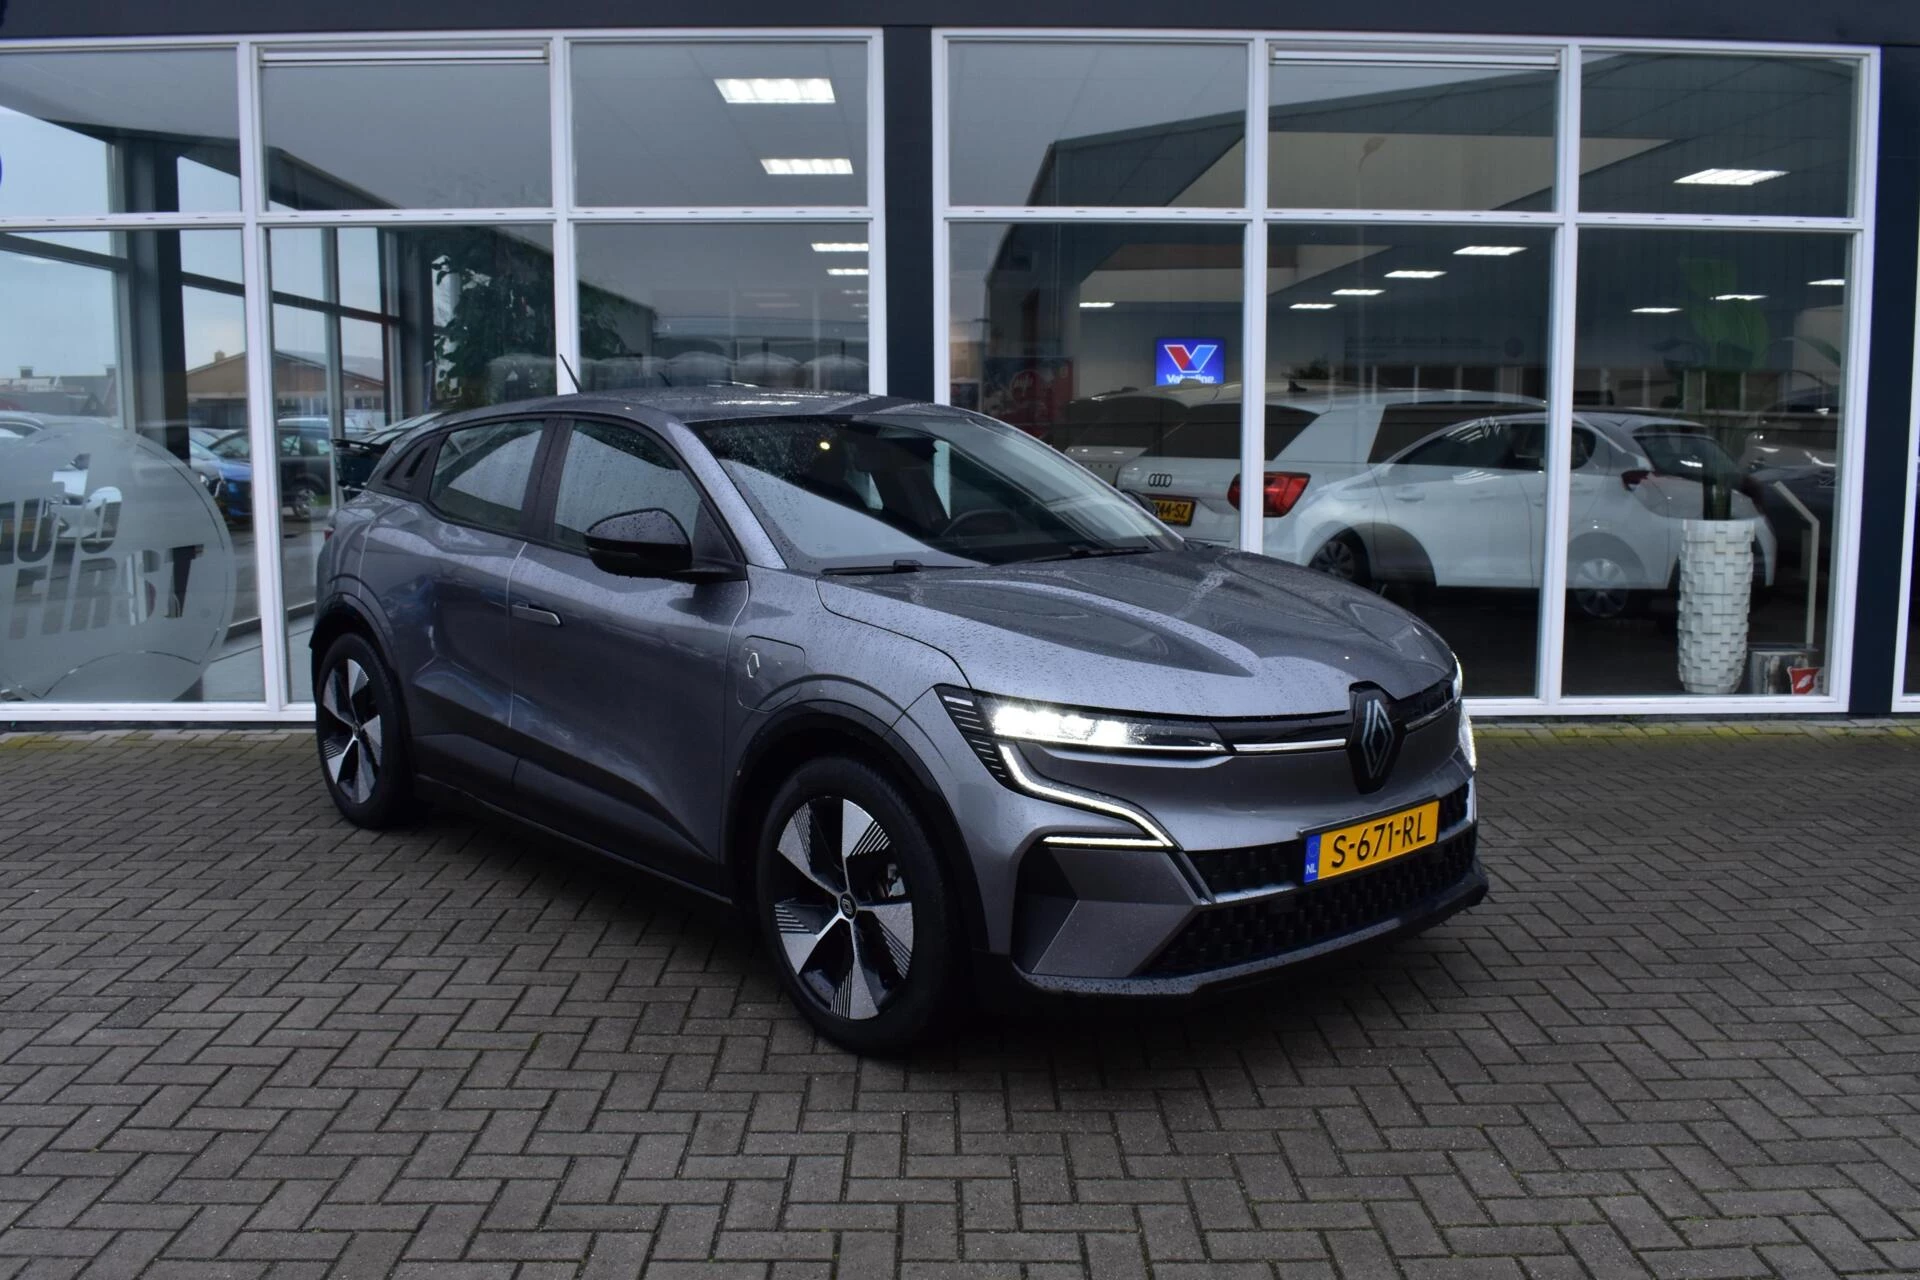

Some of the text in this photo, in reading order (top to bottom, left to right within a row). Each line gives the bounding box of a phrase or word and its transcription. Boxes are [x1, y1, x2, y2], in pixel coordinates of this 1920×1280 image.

[1166, 374, 1217, 384] Valline
[8, 544, 204, 640] FIRST
[1331, 811, 1426, 868] S-671-RL
[1306, 863, 1317, 875] NL
